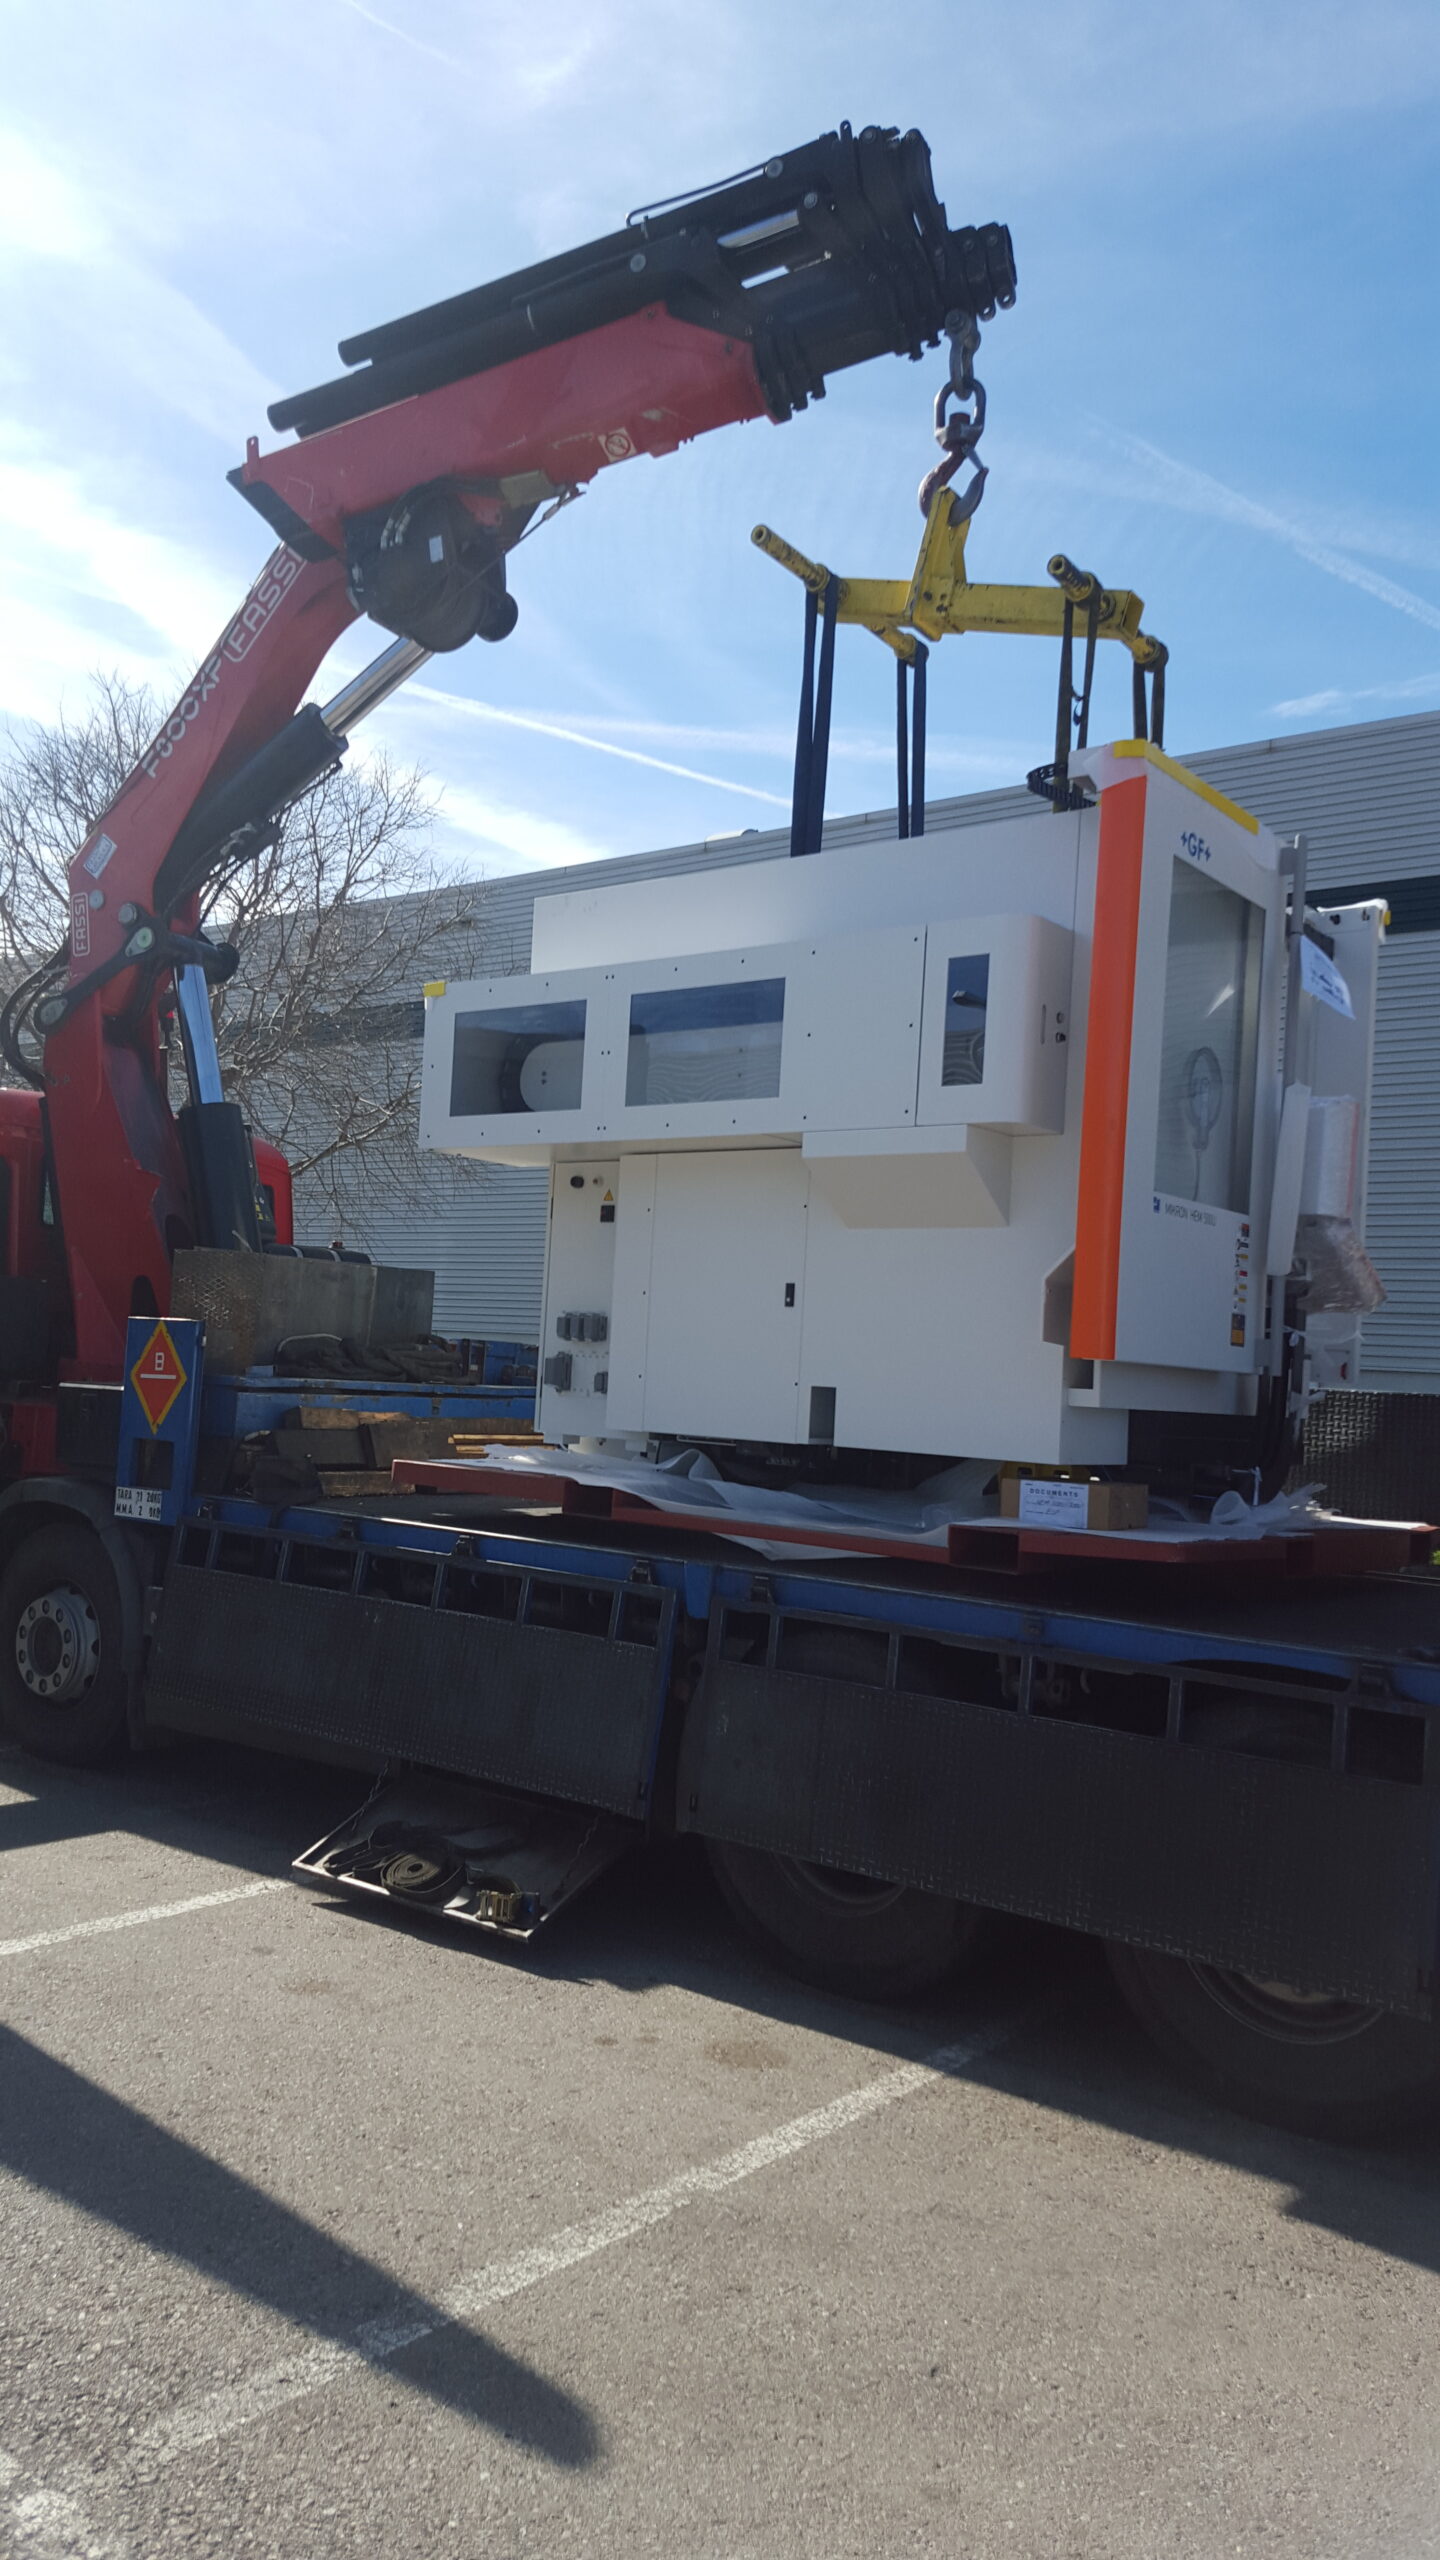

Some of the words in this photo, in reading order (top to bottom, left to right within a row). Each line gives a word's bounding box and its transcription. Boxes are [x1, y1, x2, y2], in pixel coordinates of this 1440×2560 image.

[227, 547, 303, 655] FASSI
[74, 898, 87, 951] FASSI
[155, 1352, 164, 1371] B
[117, 1488, 133, 1500] TARA
[1029, 1488, 1078, 1498] DOCUMENTS
